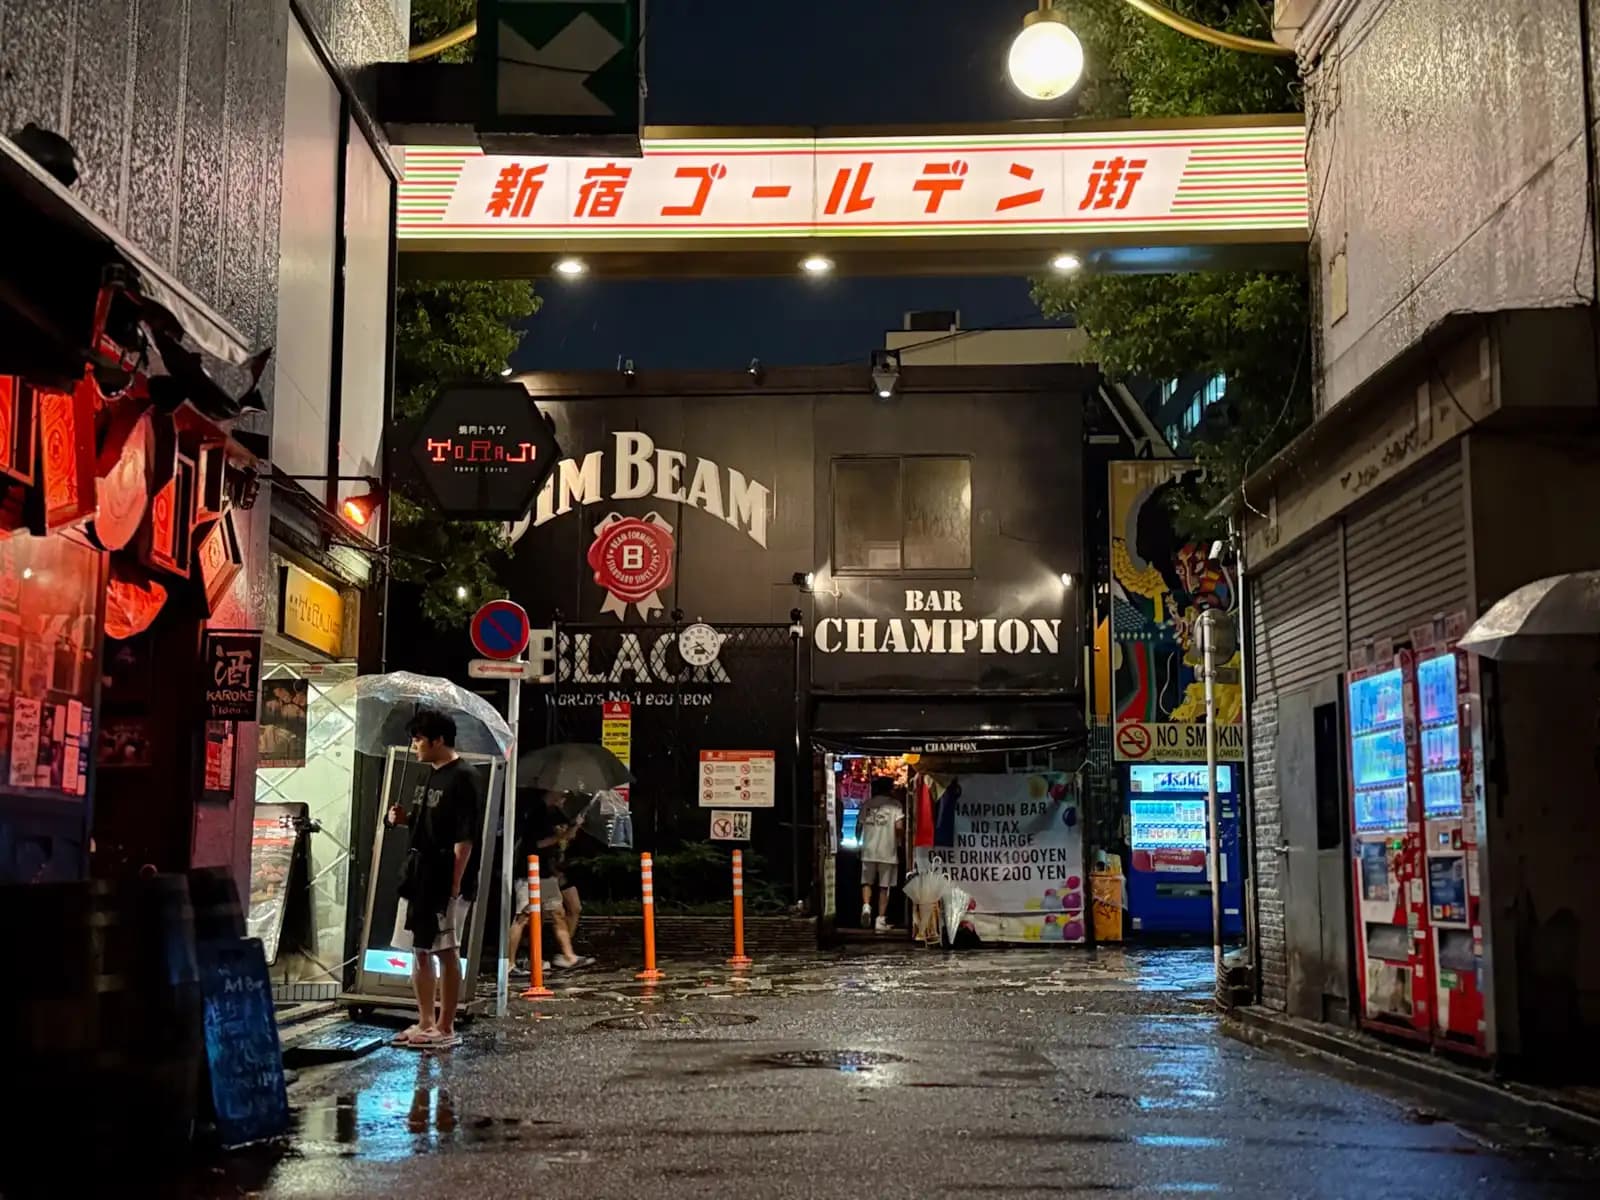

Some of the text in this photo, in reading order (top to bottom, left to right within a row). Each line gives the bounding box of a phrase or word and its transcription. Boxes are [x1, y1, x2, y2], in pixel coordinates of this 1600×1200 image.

[484, 156, 1149, 219] 新宿ゴールデン街
[611, 431, 770, 550] BEAM
[623, 545, 643, 569] B
[904, 590, 963, 612] BAR
[814, 618, 1062, 654] CHAMPION
[214, 645, 252, 688] 酒
[925, 742, 977, 752] CHAMPION
[1157, 725, 1243, 747] NO SMKIN
[953, 801, 1047, 817] HAMPION BAR
[971, 820, 1020, 833] NO TAX
[958, 833, 1034, 848] NO CHARGE
[928, 849, 955, 864] ONE
[1002, 867, 1031, 881] 200
[1038, 865, 1066, 880] YEN
